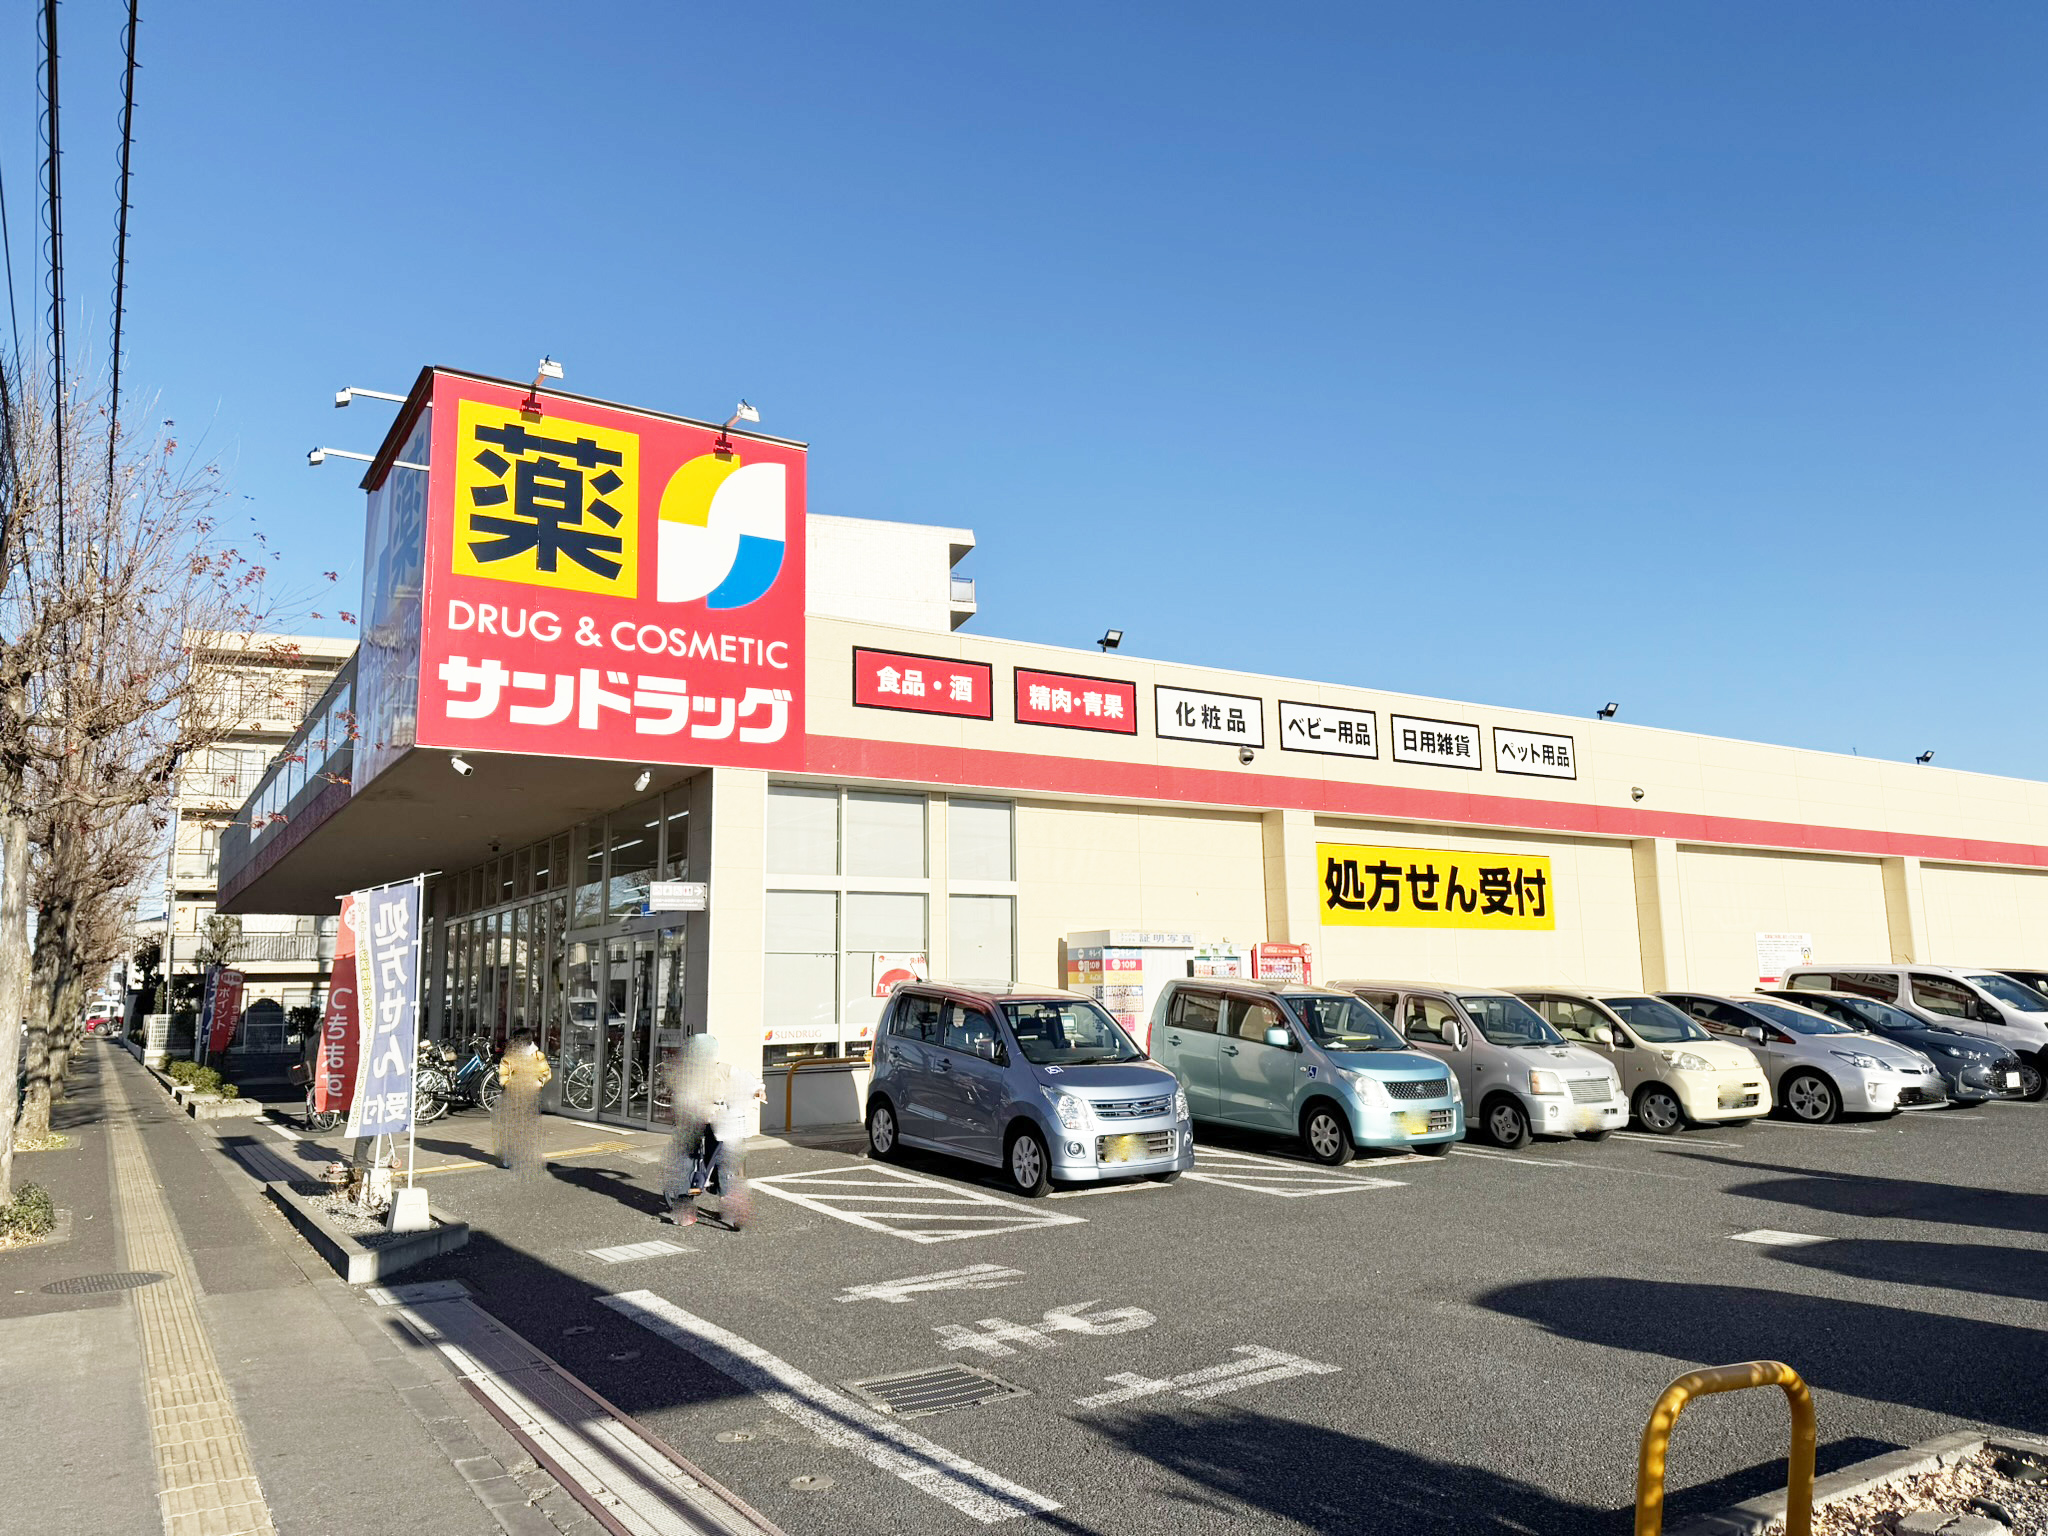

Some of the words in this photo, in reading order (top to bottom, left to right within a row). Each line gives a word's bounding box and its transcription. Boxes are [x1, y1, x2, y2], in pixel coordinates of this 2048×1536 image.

[467, 423, 624, 580] 薬
[448, 599, 562, 642] DRUG
[575, 615, 603, 648] &
[611, 621, 789, 669] COSMETIC
[438, 655, 793, 744] サンドラッグ
[876, 665, 973, 703] 食品・酒
[1028, 683, 1124, 719] 精肉・青果
[1175, 700, 1246, 733] 化粧品
[1288, 717, 1371, 746] ベビー用品
[1403, 728, 1471, 758] 日用雑貨
[1501, 742, 1570, 768] ペット用品
[1325, 857, 1547, 917] 処方せん受付
[1139, 933, 1192, 943] 証明写真
[774, 1029, 822, 1039] SUNDRUG
